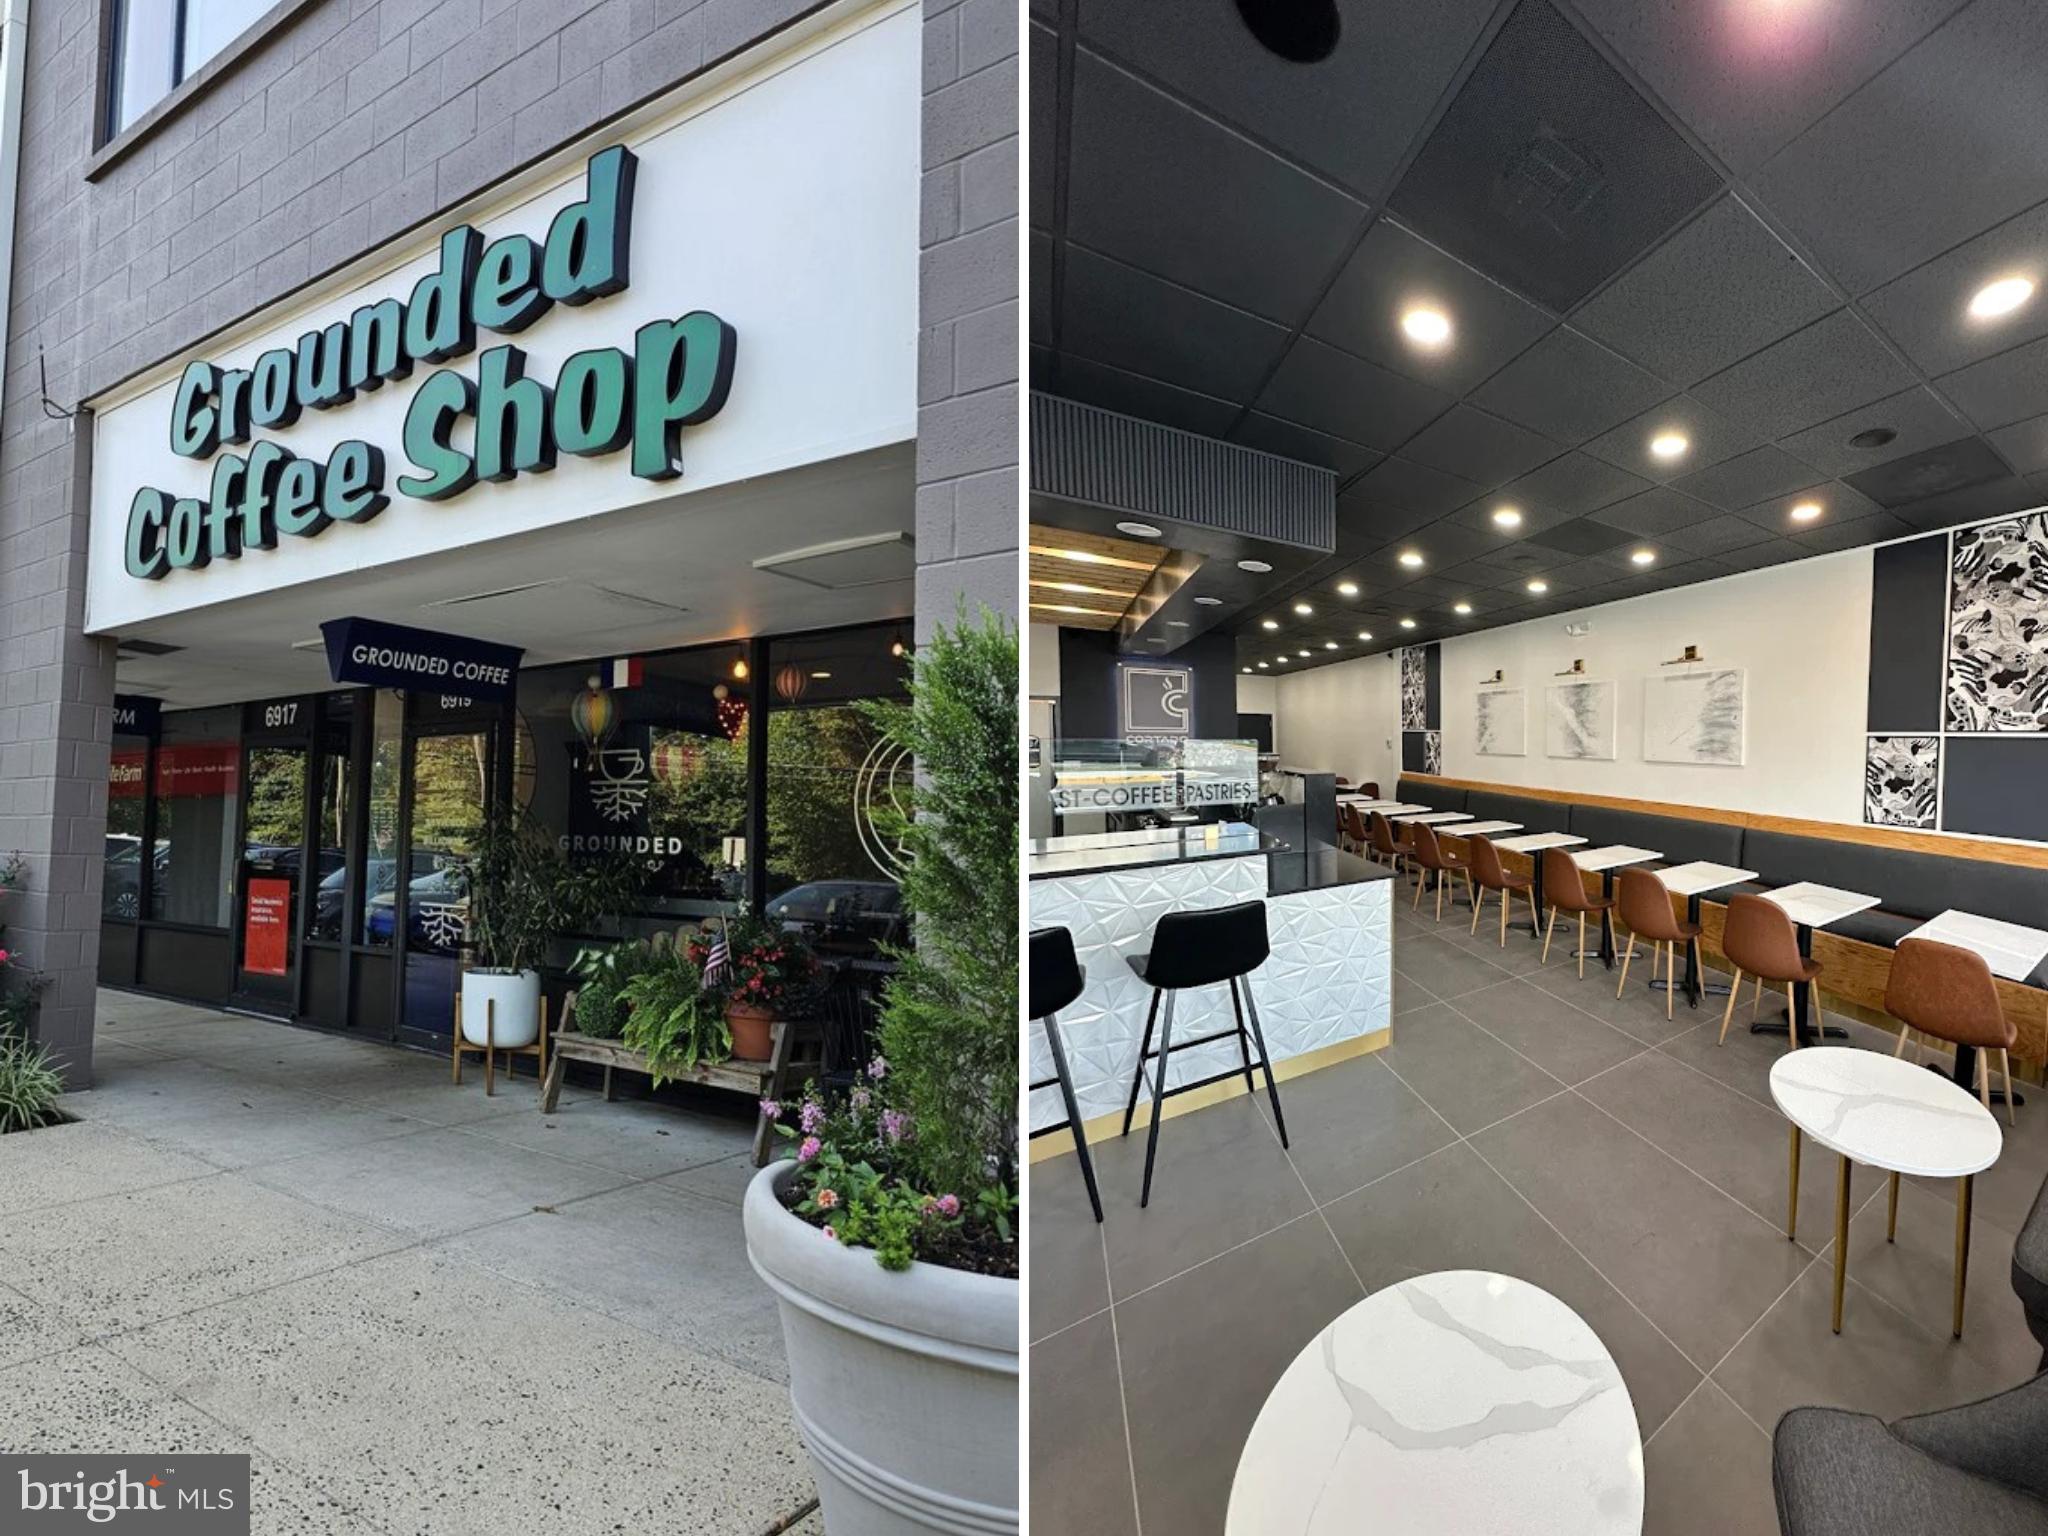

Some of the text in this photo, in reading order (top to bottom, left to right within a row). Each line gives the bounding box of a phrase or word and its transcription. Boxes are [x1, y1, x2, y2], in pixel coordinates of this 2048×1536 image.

[170, 143, 640, 460] Grounded
[125, 309, 738, 581] Coffee Shop
[352, 644, 510, 685] GROUNDED COFFEE
[265, 703, 298, 727] 6917
[559, 834, 682, 855] GROUNDED
